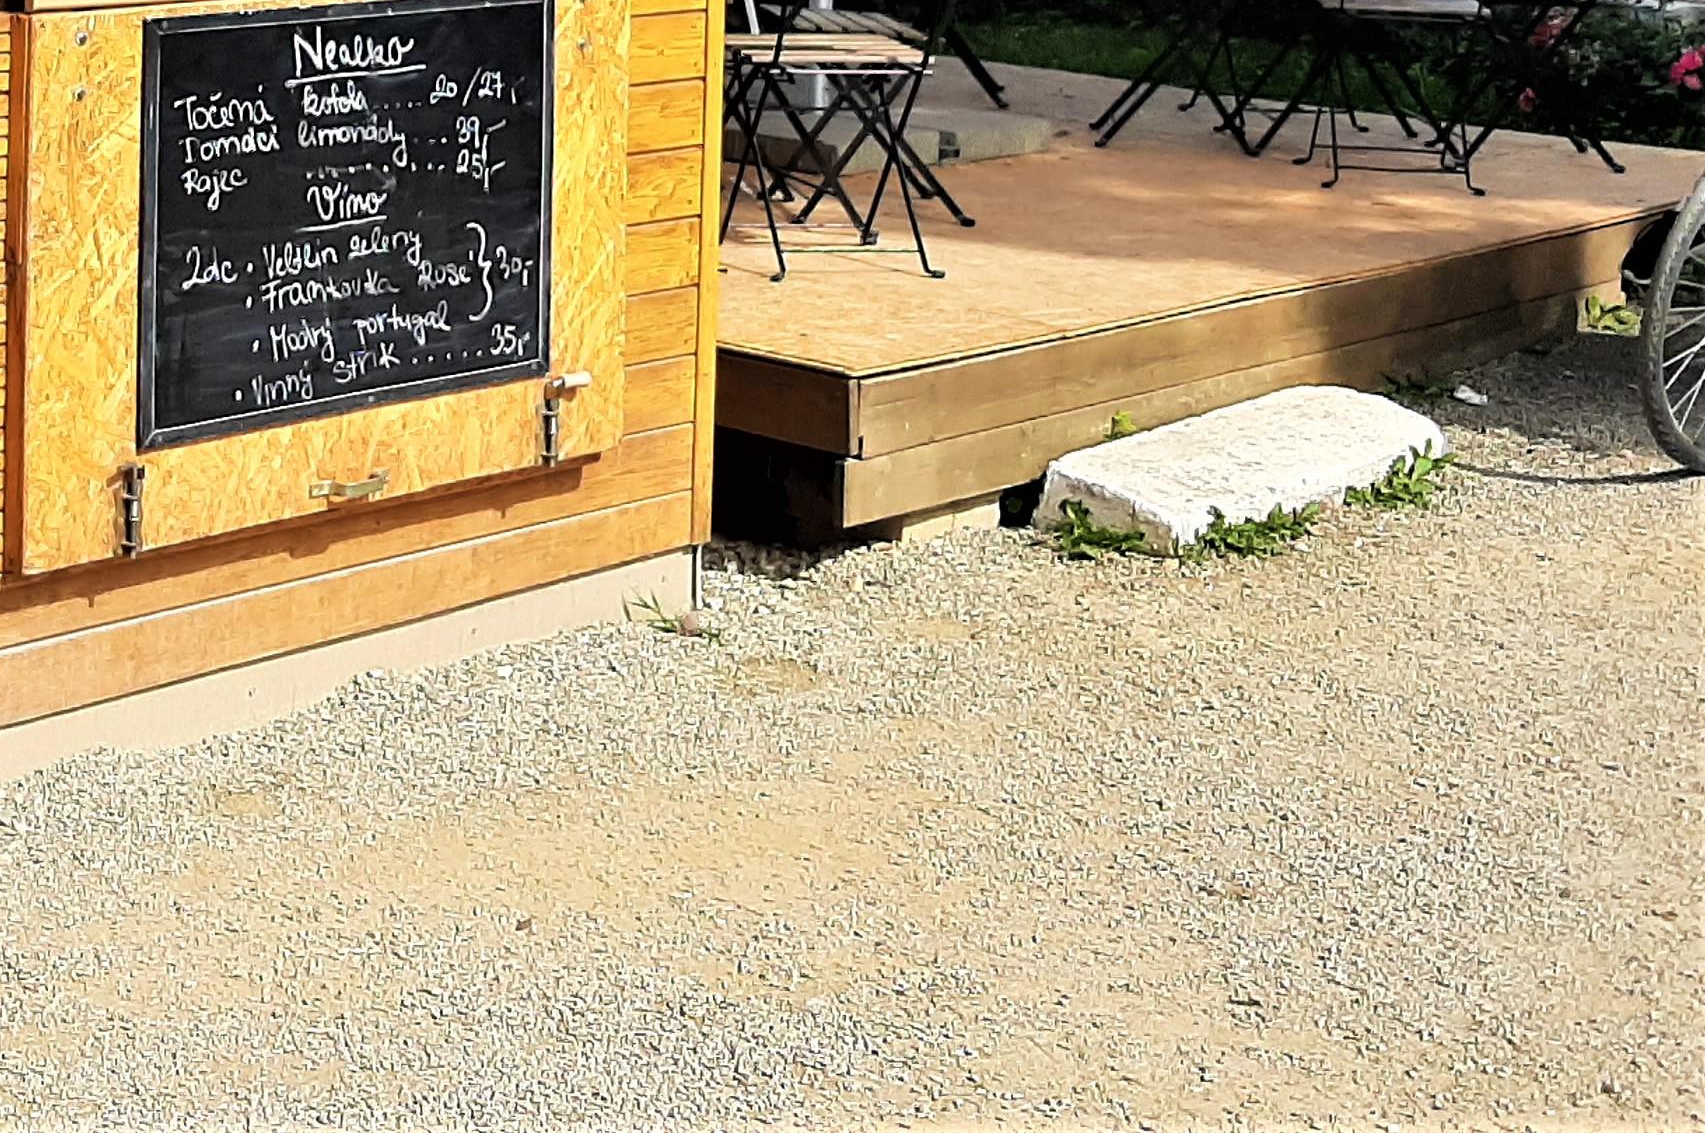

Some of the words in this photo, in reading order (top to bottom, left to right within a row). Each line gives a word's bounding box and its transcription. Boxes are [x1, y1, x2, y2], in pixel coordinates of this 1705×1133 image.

[293, 25, 415, 78] Nealko
[174, 84, 275, 131] Točená
[297, 114, 408, 168] limonády
[181, 168, 248, 211] Rajec
[306, 181, 388, 221] Víno
[352, 300, 452, 347] portugal
